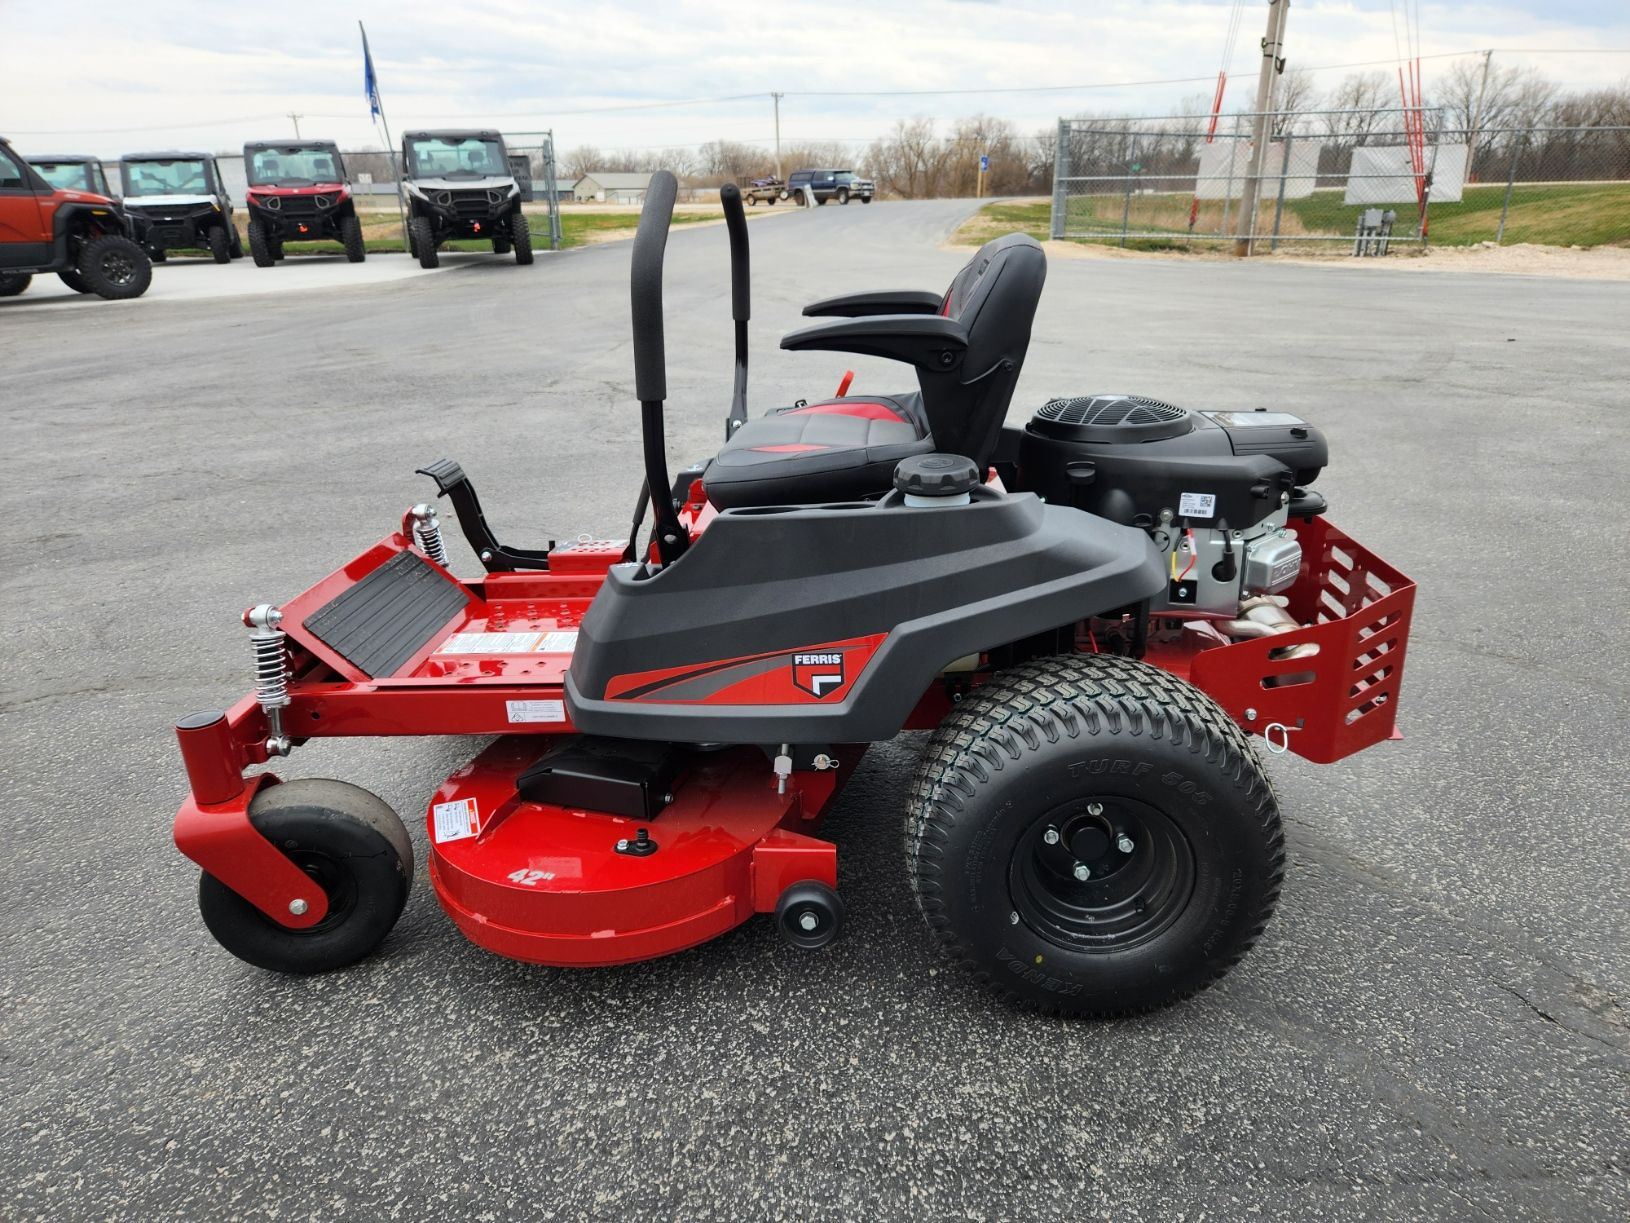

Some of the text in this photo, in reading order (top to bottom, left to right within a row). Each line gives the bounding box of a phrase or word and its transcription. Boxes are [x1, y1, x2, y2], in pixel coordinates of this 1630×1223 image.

[795, 654, 841, 664] FERRIS
[1067, 758, 1155, 778] TURF
[507, 868, 556, 886] 42"
[993, 946, 1084, 997] KENDA
